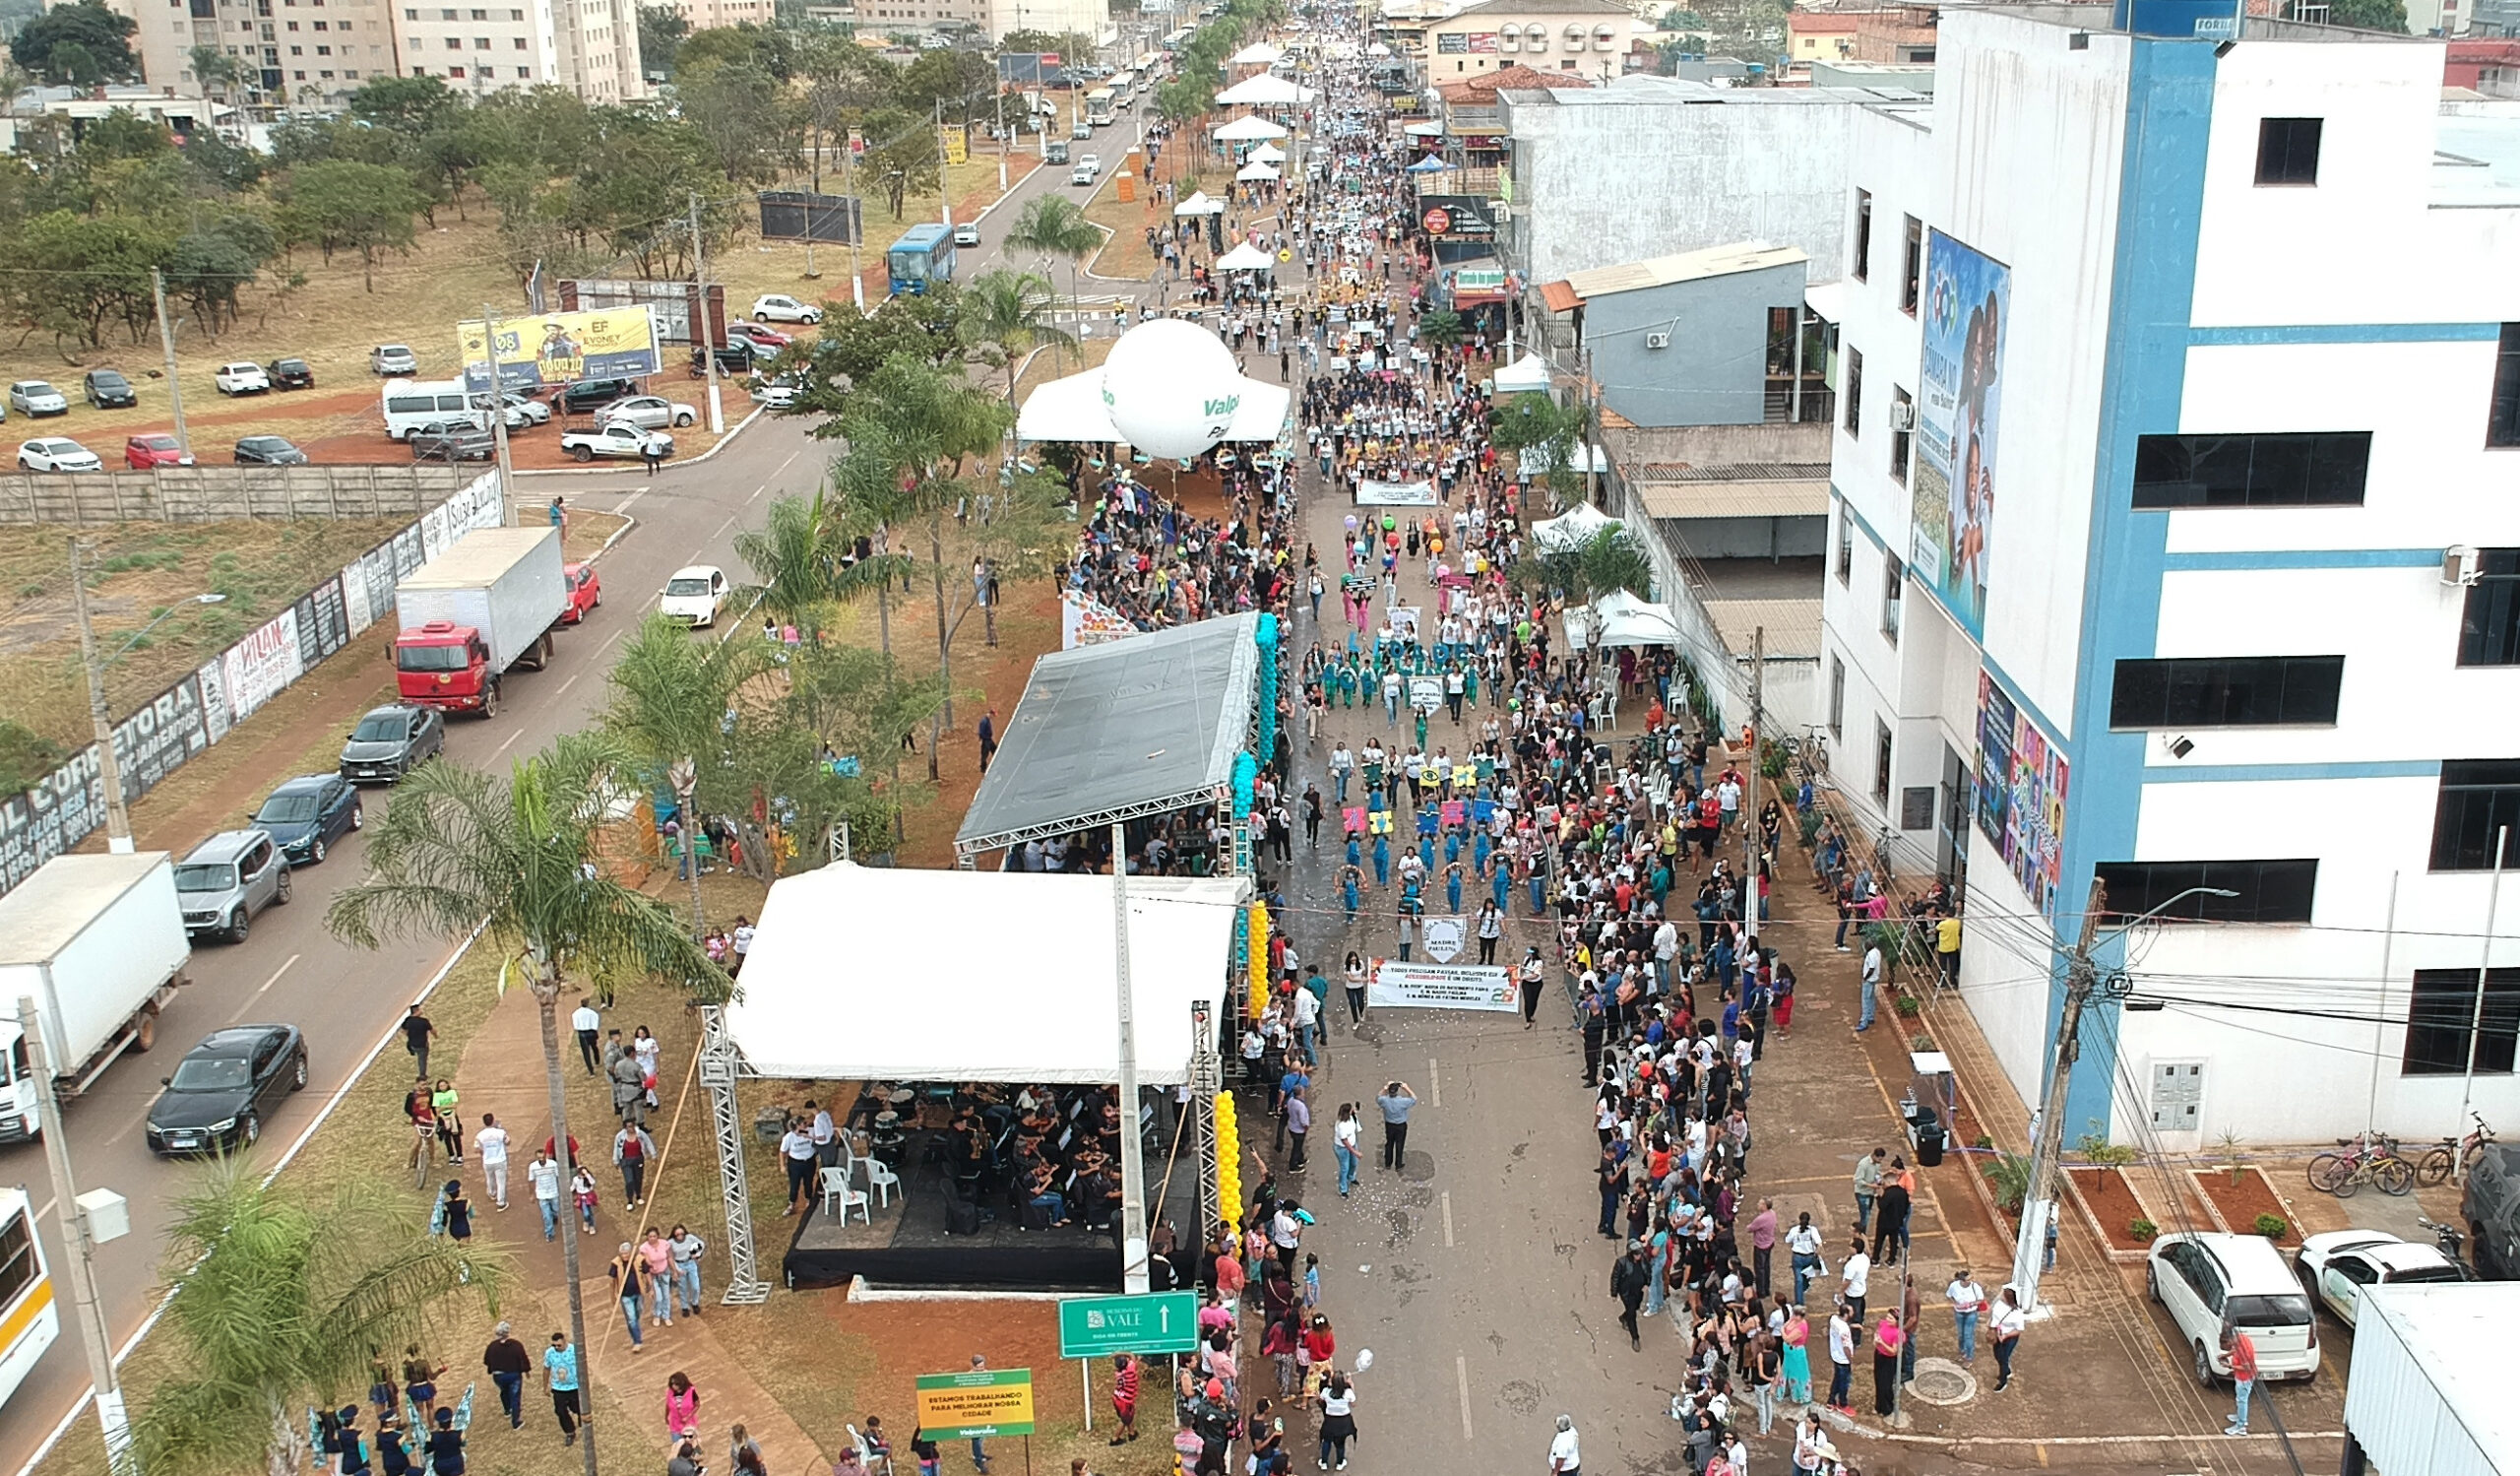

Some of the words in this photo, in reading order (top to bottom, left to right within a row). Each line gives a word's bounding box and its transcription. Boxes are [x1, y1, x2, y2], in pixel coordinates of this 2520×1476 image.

[494, 335, 516, 351] 08
[1107, 1313, 1143, 1327] VALE
[929, 1394, 964, 1403] ESTAMOS
[966, 1391, 1022, 1401] TRABALHANDO
[931, 1402, 951, 1411] PARA
[953, 1402, 993, 1411] MELHORAR
